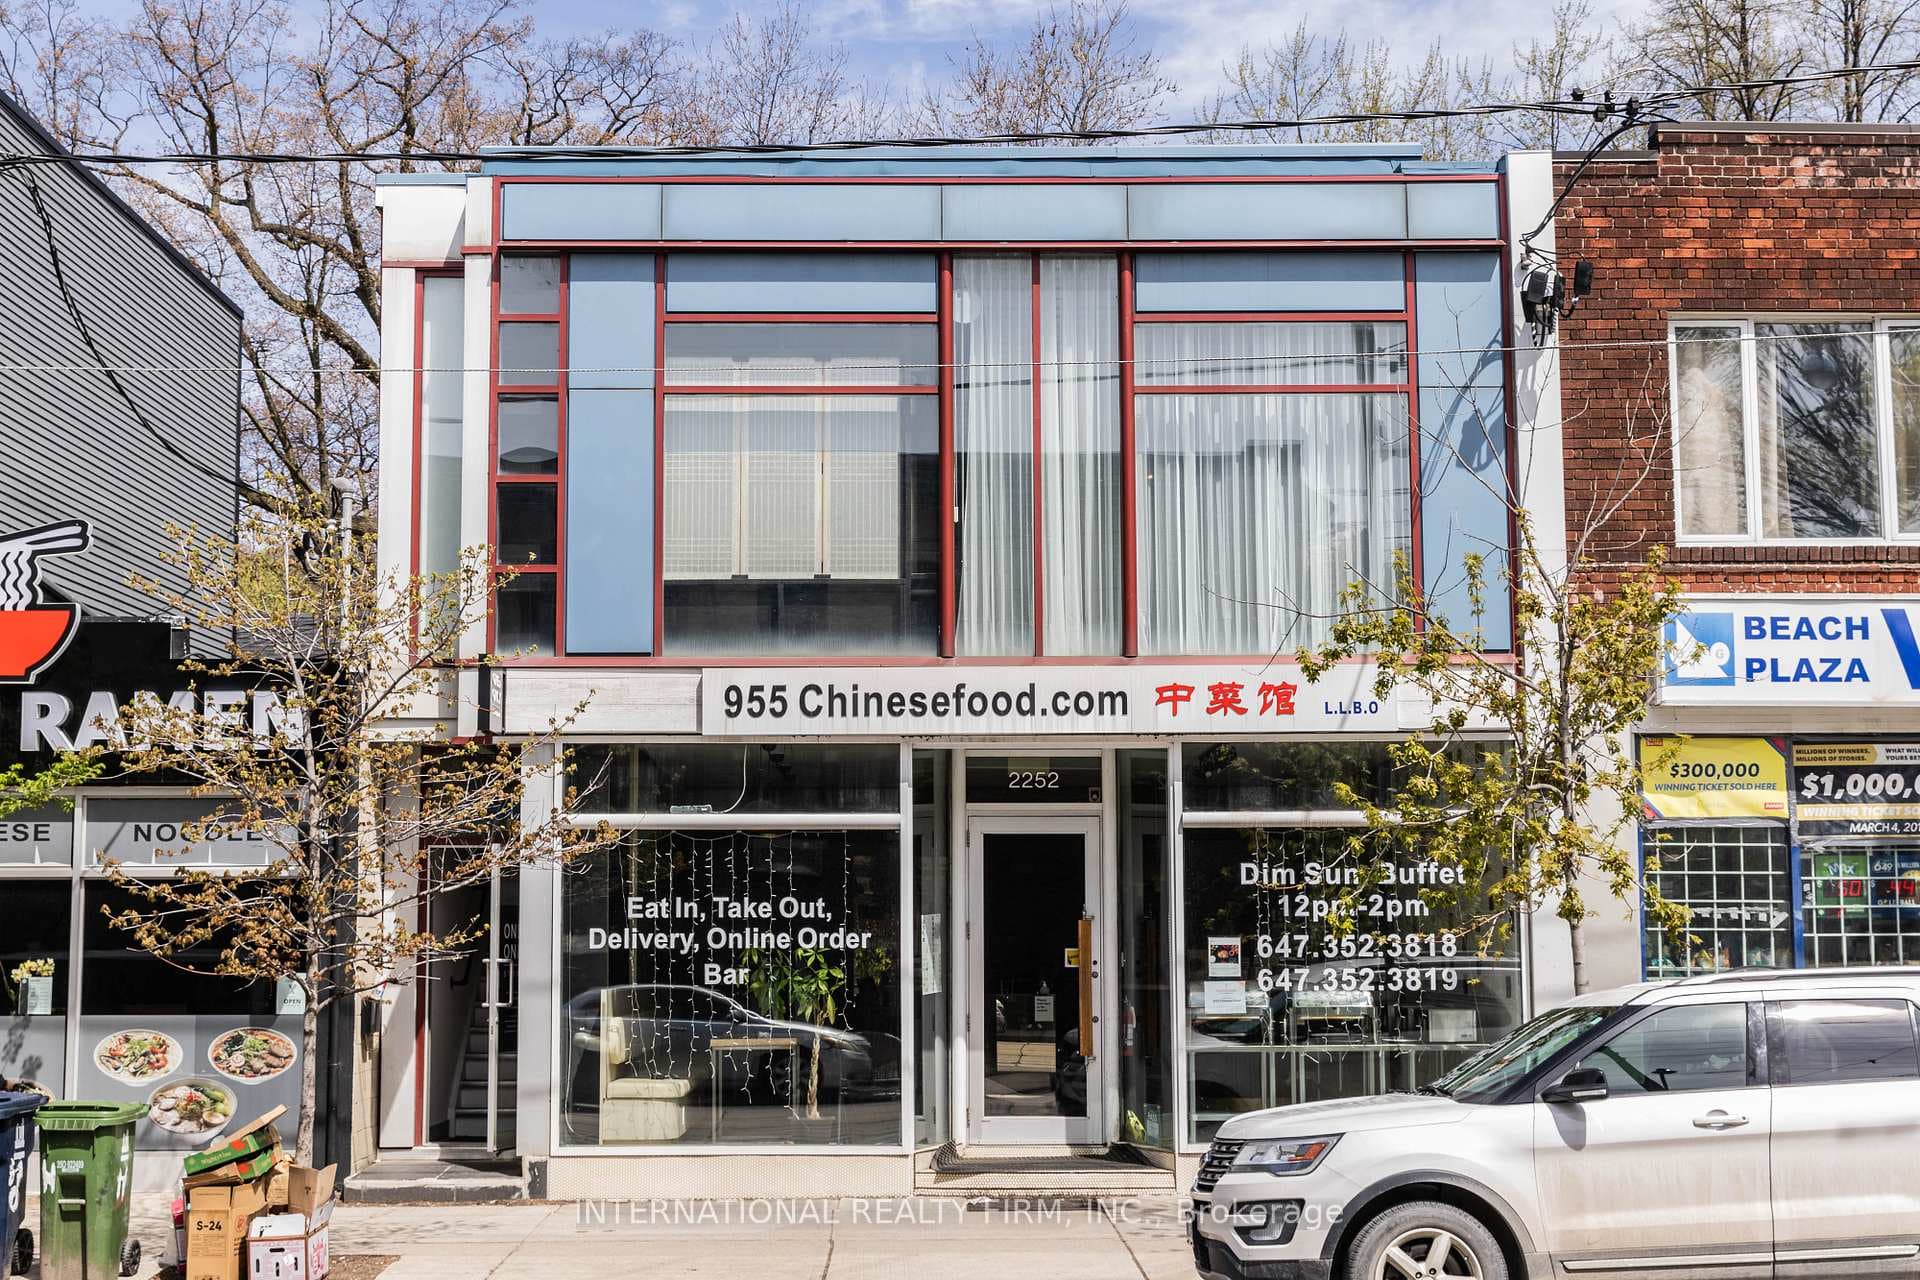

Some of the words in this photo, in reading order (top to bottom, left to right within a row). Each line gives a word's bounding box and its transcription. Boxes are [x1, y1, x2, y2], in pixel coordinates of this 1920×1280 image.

[1744, 616, 1869, 640] BEACH
[1745, 658, 1870, 683] PLAZA
[724, 685, 788, 718] 955
[799, 683, 1129, 718] Chinesefood.com
[1154, 681, 1298, 717] 中菜馆
[1324, 701, 1378, 715] L.L.B.O
[20, 691, 304, 752] RAMEN
[1008, 772, 1060, 789] 2252
[1670, 763, 1760, 780] $300,000
[1655, 783, 1696, 792] WINNING
[1698, 783, 1729, 791] TICKET
[1729, 783, 1753, 791] SOLD
[1754, 783, 1777, 791] HERE
[1849, 822, 1890, 833] MARCH
[1891, 822, 1901, 834] 4,
[1240, 862, 1296, 886] Dim
[1378, 862, 1466, 886] Buffet
[627, 897, 669, 919] Eat
[676, 897, 706, 921] In,
[713, 897, 772, 919] Take
[780, 897, 832, 921] Out,
[589, 928, 700, 954] Delivery,
[707, 928, 791, 950] Online
[797, 928, 872, 950] Order
[1257, 933, 1457, 958] 647.352.3818
[704, 963, 750, 985] Bar
[1257, 967, 1458, 992] 647.352.3819
[196, 1220, 222, 1231] S-24
